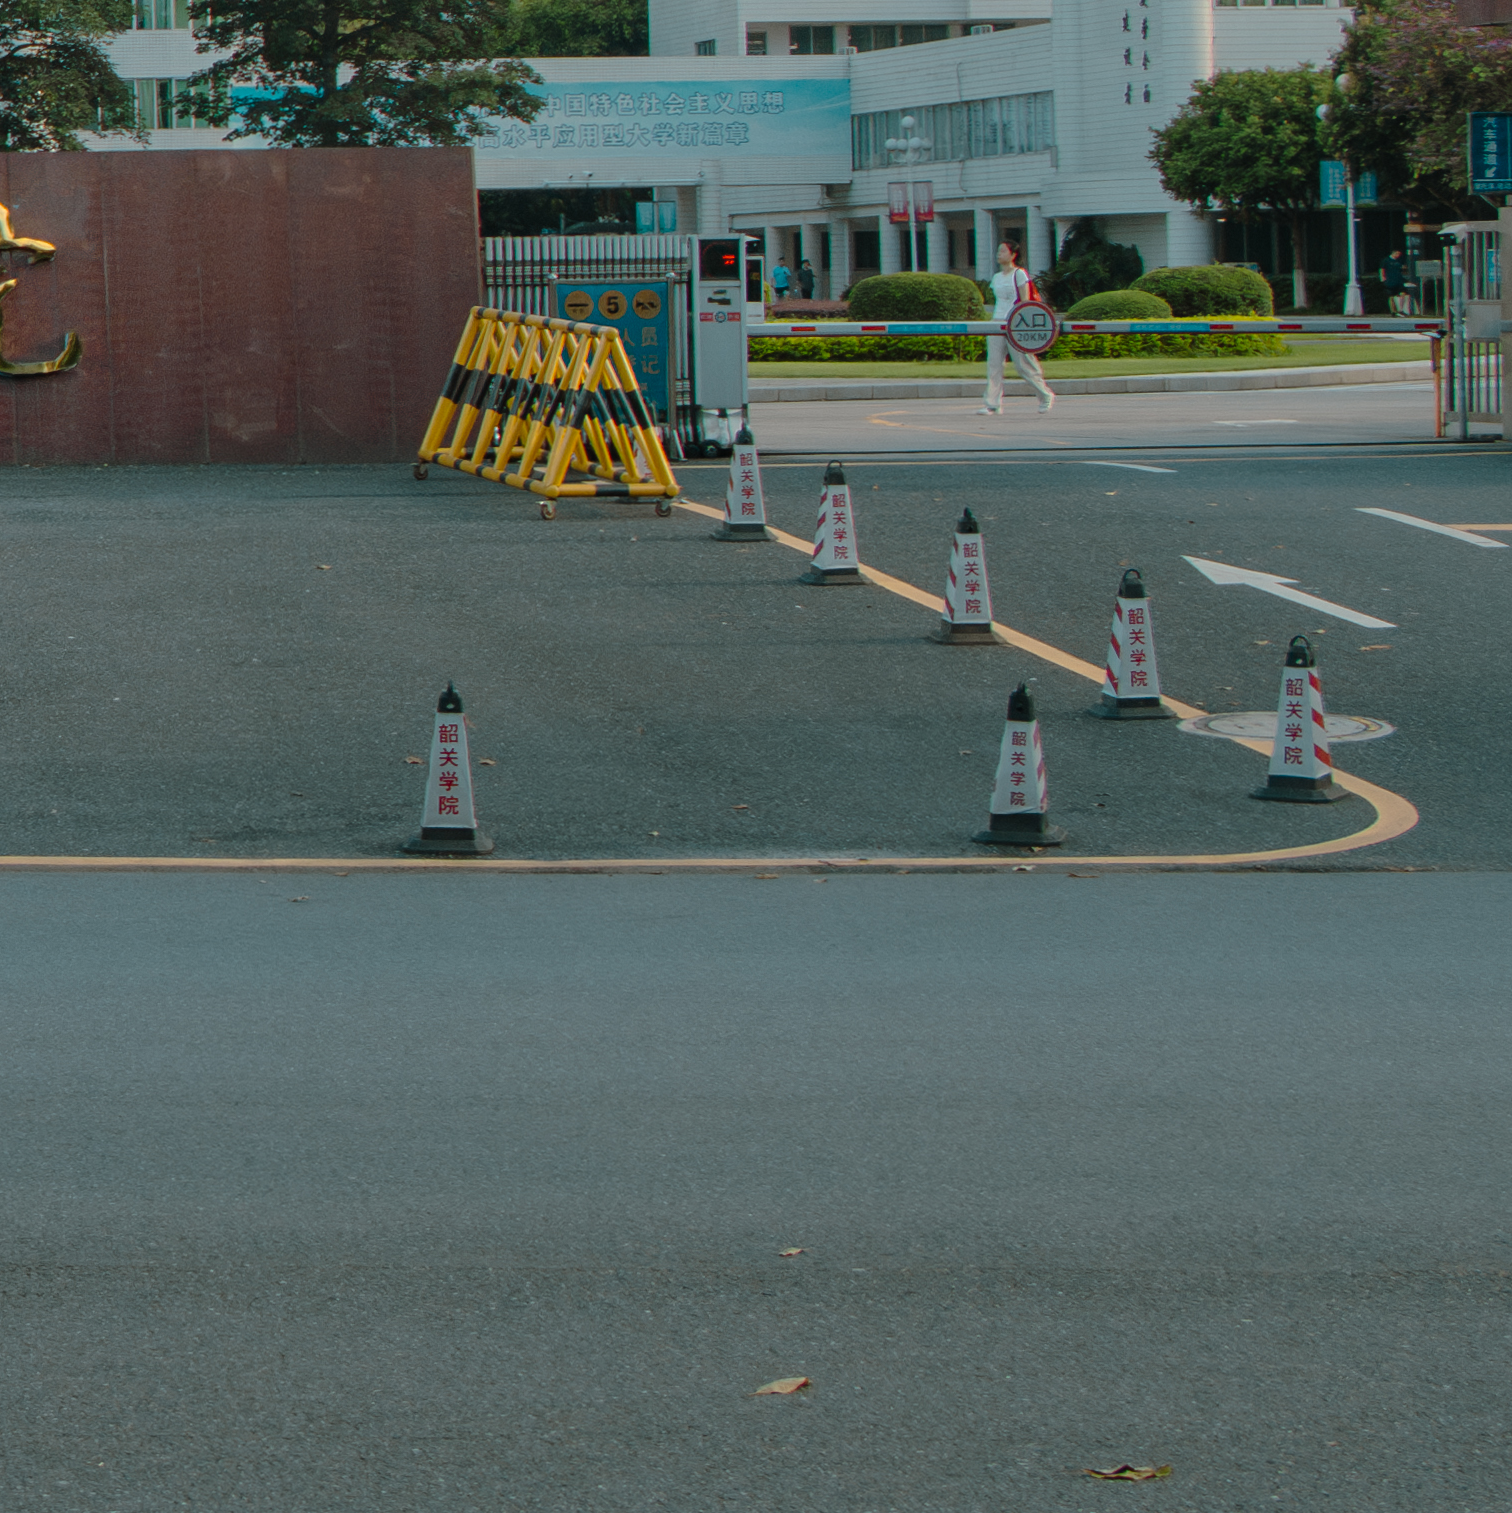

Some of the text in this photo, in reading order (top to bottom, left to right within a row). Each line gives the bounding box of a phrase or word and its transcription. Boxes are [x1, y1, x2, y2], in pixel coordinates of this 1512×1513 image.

[607, 296, 619, 314] 5
[1015, 312, 1046, 328] 入口
[739, 453, 756, 517] 韶关学院
[832, 494, 848, 560] 韶关学院
[963, 542, 981, 614] 韶关学院
[1128, 608, 1147, 687] 韶关学院
[1284, 678, 1303, 765] 韶关学院
[439, 723, 459, 815] 韶关学院
[1010, 731, 1027, 806] 韶关学院
